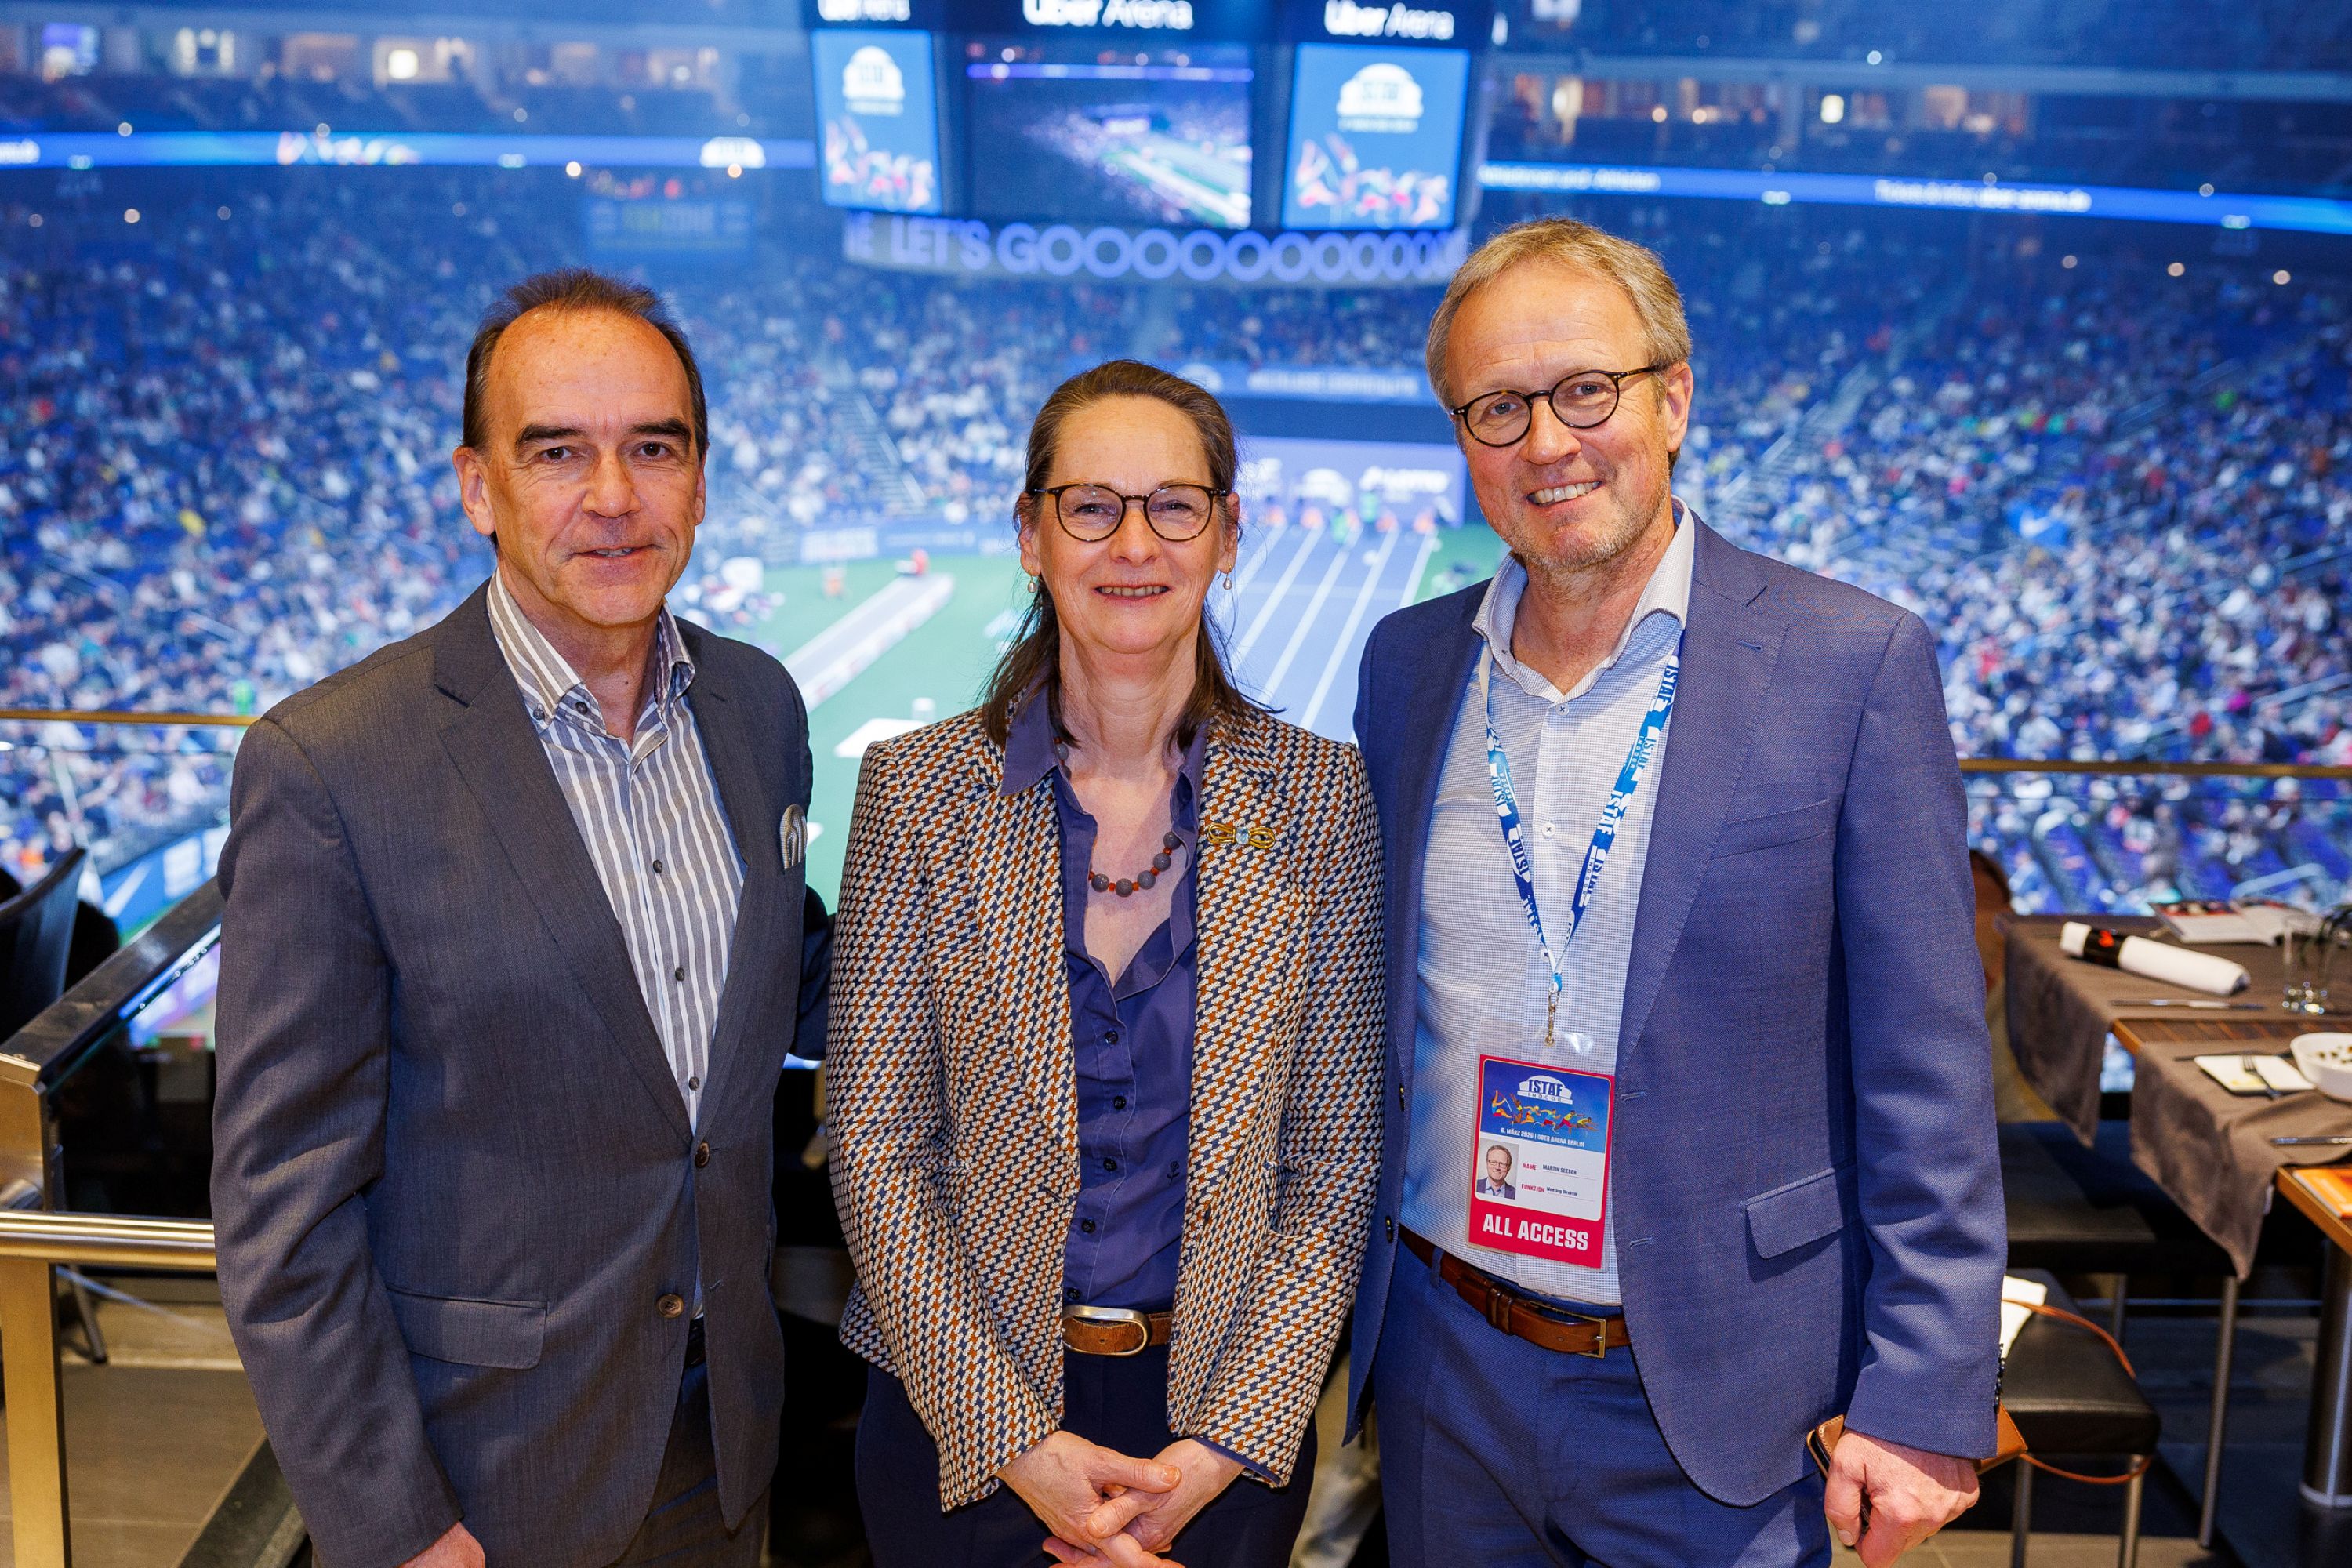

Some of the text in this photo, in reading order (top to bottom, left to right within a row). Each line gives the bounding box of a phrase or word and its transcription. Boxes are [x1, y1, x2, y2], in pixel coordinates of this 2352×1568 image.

[1657, 665, 1679, 702] ISTAF
[1638, 738, 1657, 770] ISTAF
[1596, 789, 1624, 836] ISTAF
[1508, 839, 1530, 876] ISTAF
[1528, 1079, 1563, 1097] ISTAF
[1567, 1139, 1584, 1148] BERLIN
[1521, 1183, 1544, 1193] FUNKTION
[1482, 1213, 1589, 1251] ALL ACCESS
